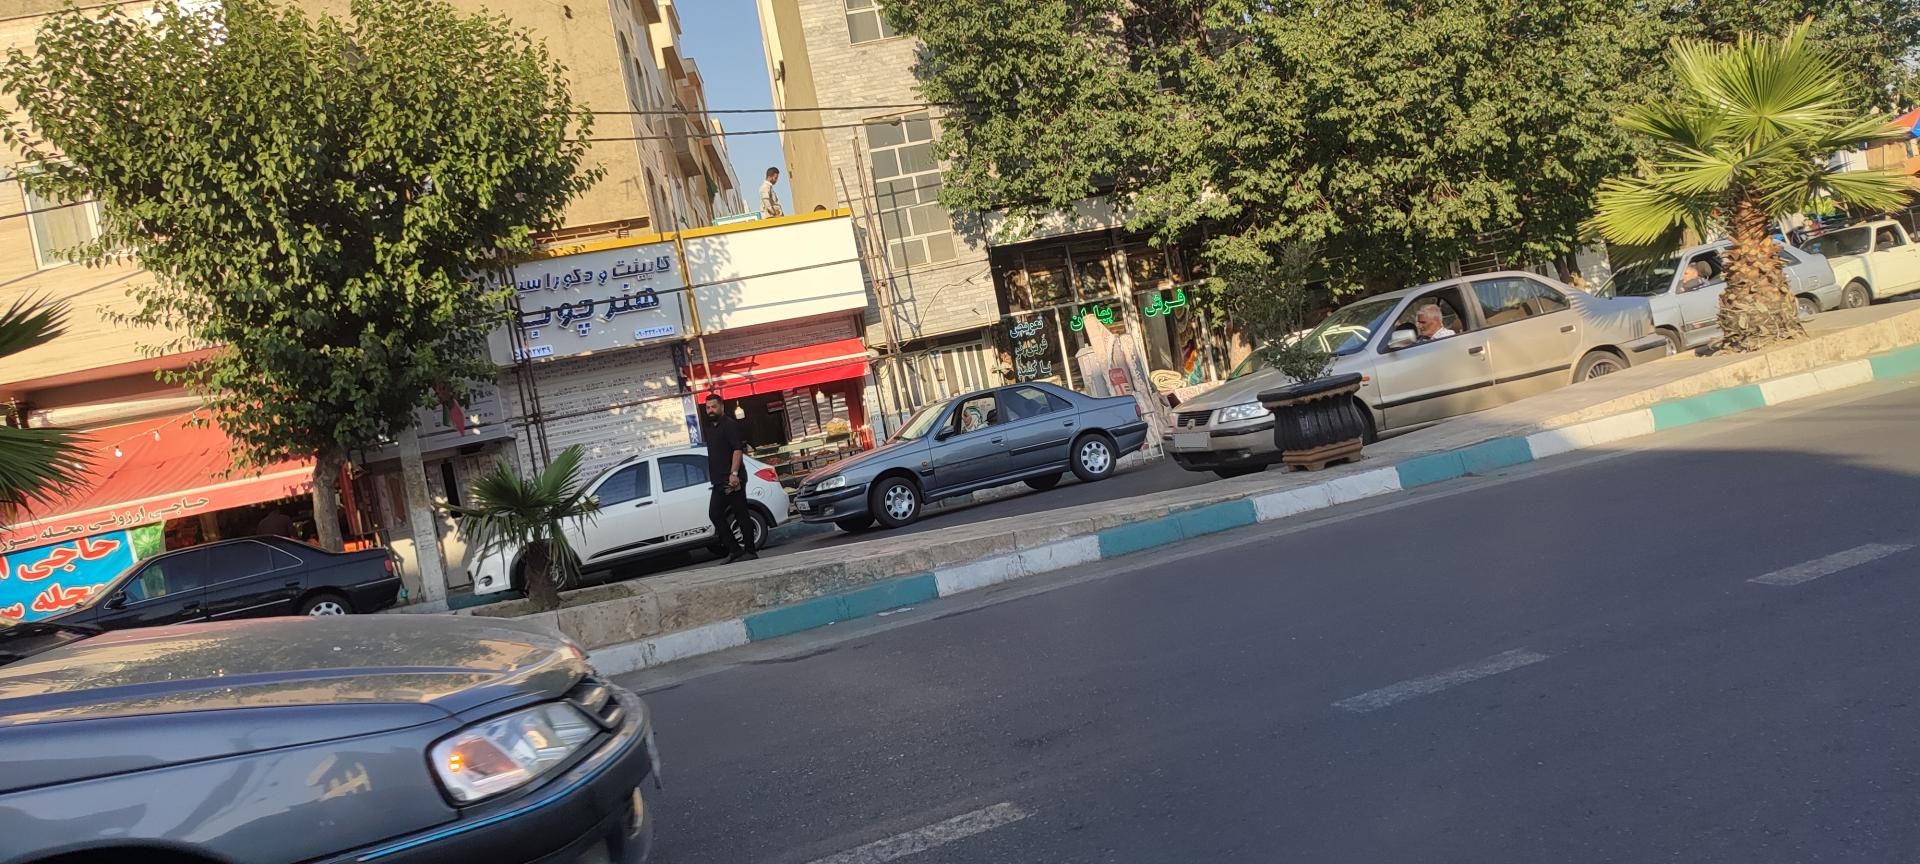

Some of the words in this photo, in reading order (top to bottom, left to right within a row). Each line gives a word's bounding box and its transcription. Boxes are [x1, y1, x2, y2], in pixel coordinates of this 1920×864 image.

[598, 269, 609, 286] و
[612, 255, 671, 281] کابینت
[603, 282, 661, 321] هنر
[1145, 288, 1186, 317] فرش
[518, 299, 595, 338] چوب
[1010, 313, 1044, 339] تعویض
[1070, 304, 1114, 331] بهاان
[88, 506, 146, 532] ارزونی
[148, 496, 209, 521] حاجی
[40, 524, 84, 539] محله
[17, 536, 120, 582] حاجی
